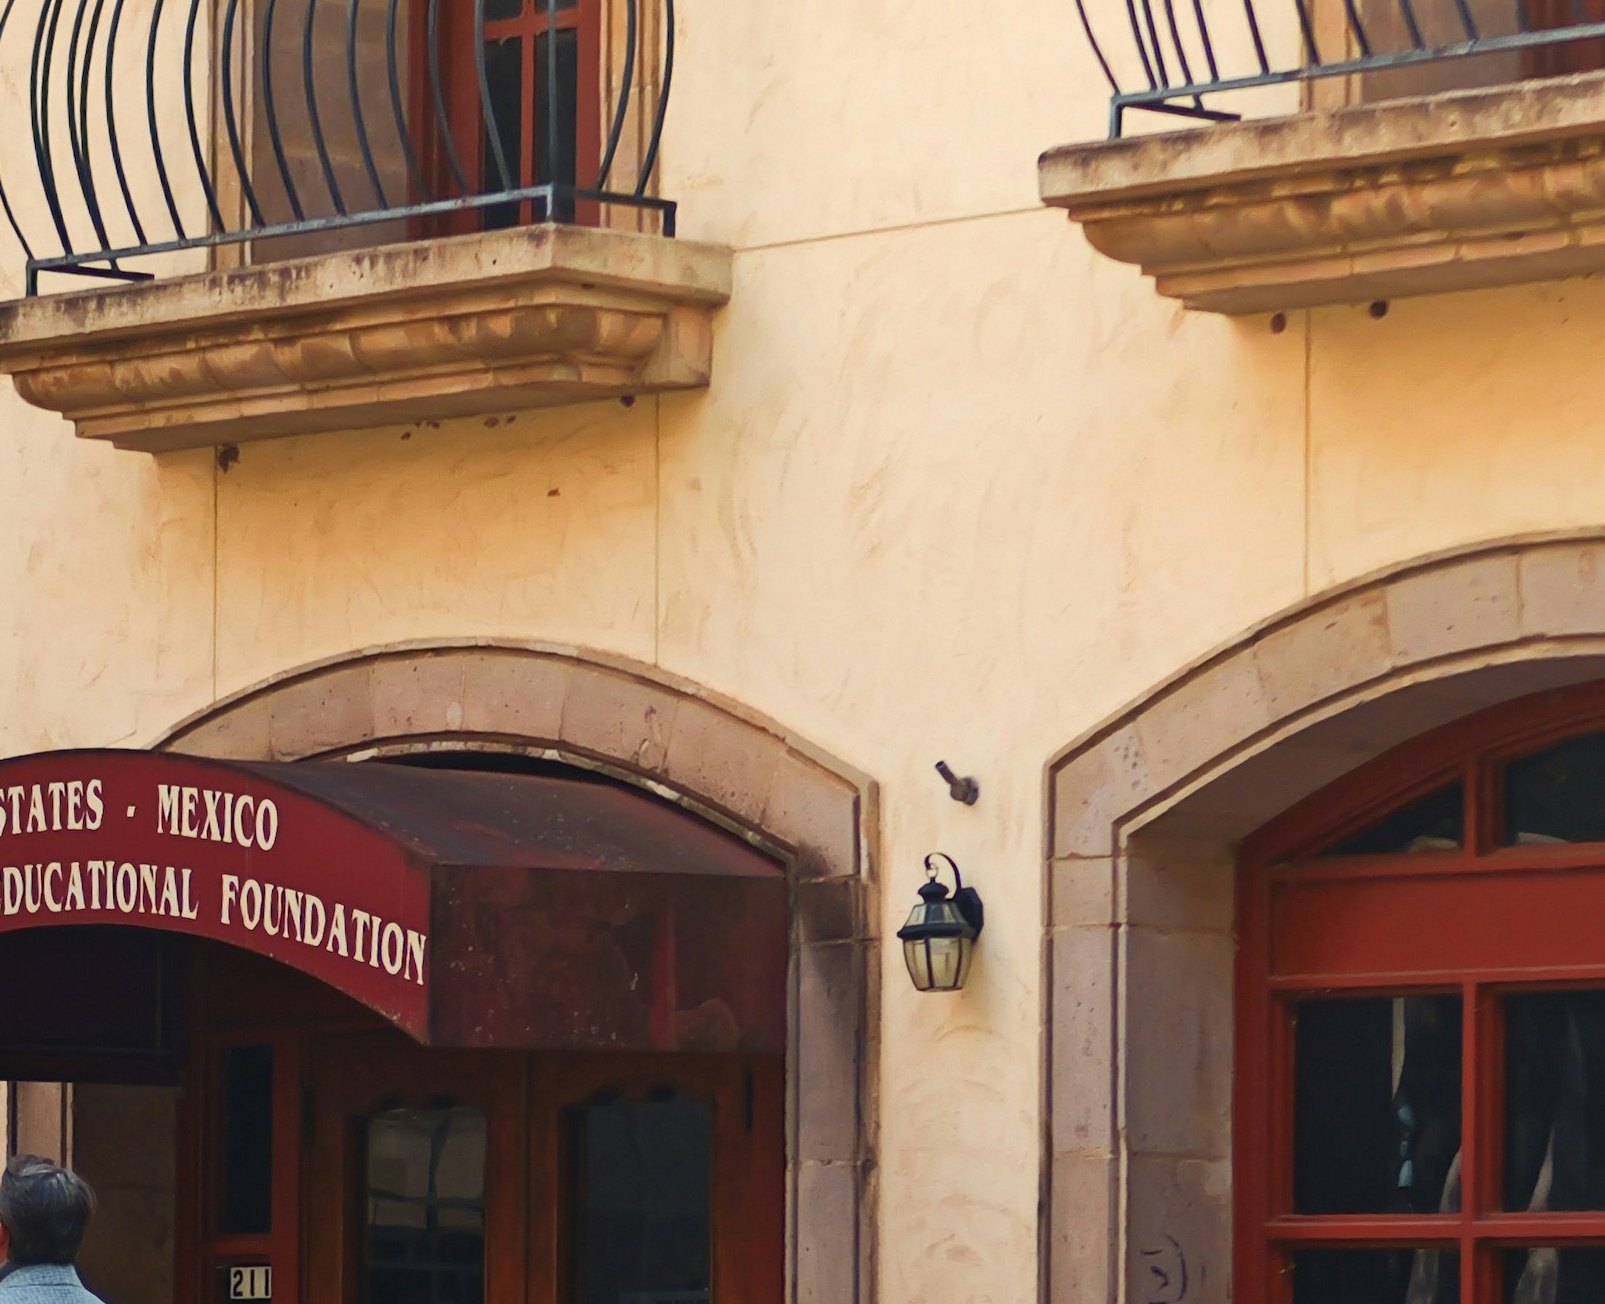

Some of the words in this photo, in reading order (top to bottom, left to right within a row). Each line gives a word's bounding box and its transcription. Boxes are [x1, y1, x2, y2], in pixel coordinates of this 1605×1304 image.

[157, 784, 278, 851] MEXICO
[220, 874, 427, 986] FOUNDATION
[233, 1269, 269, 1297] 211
